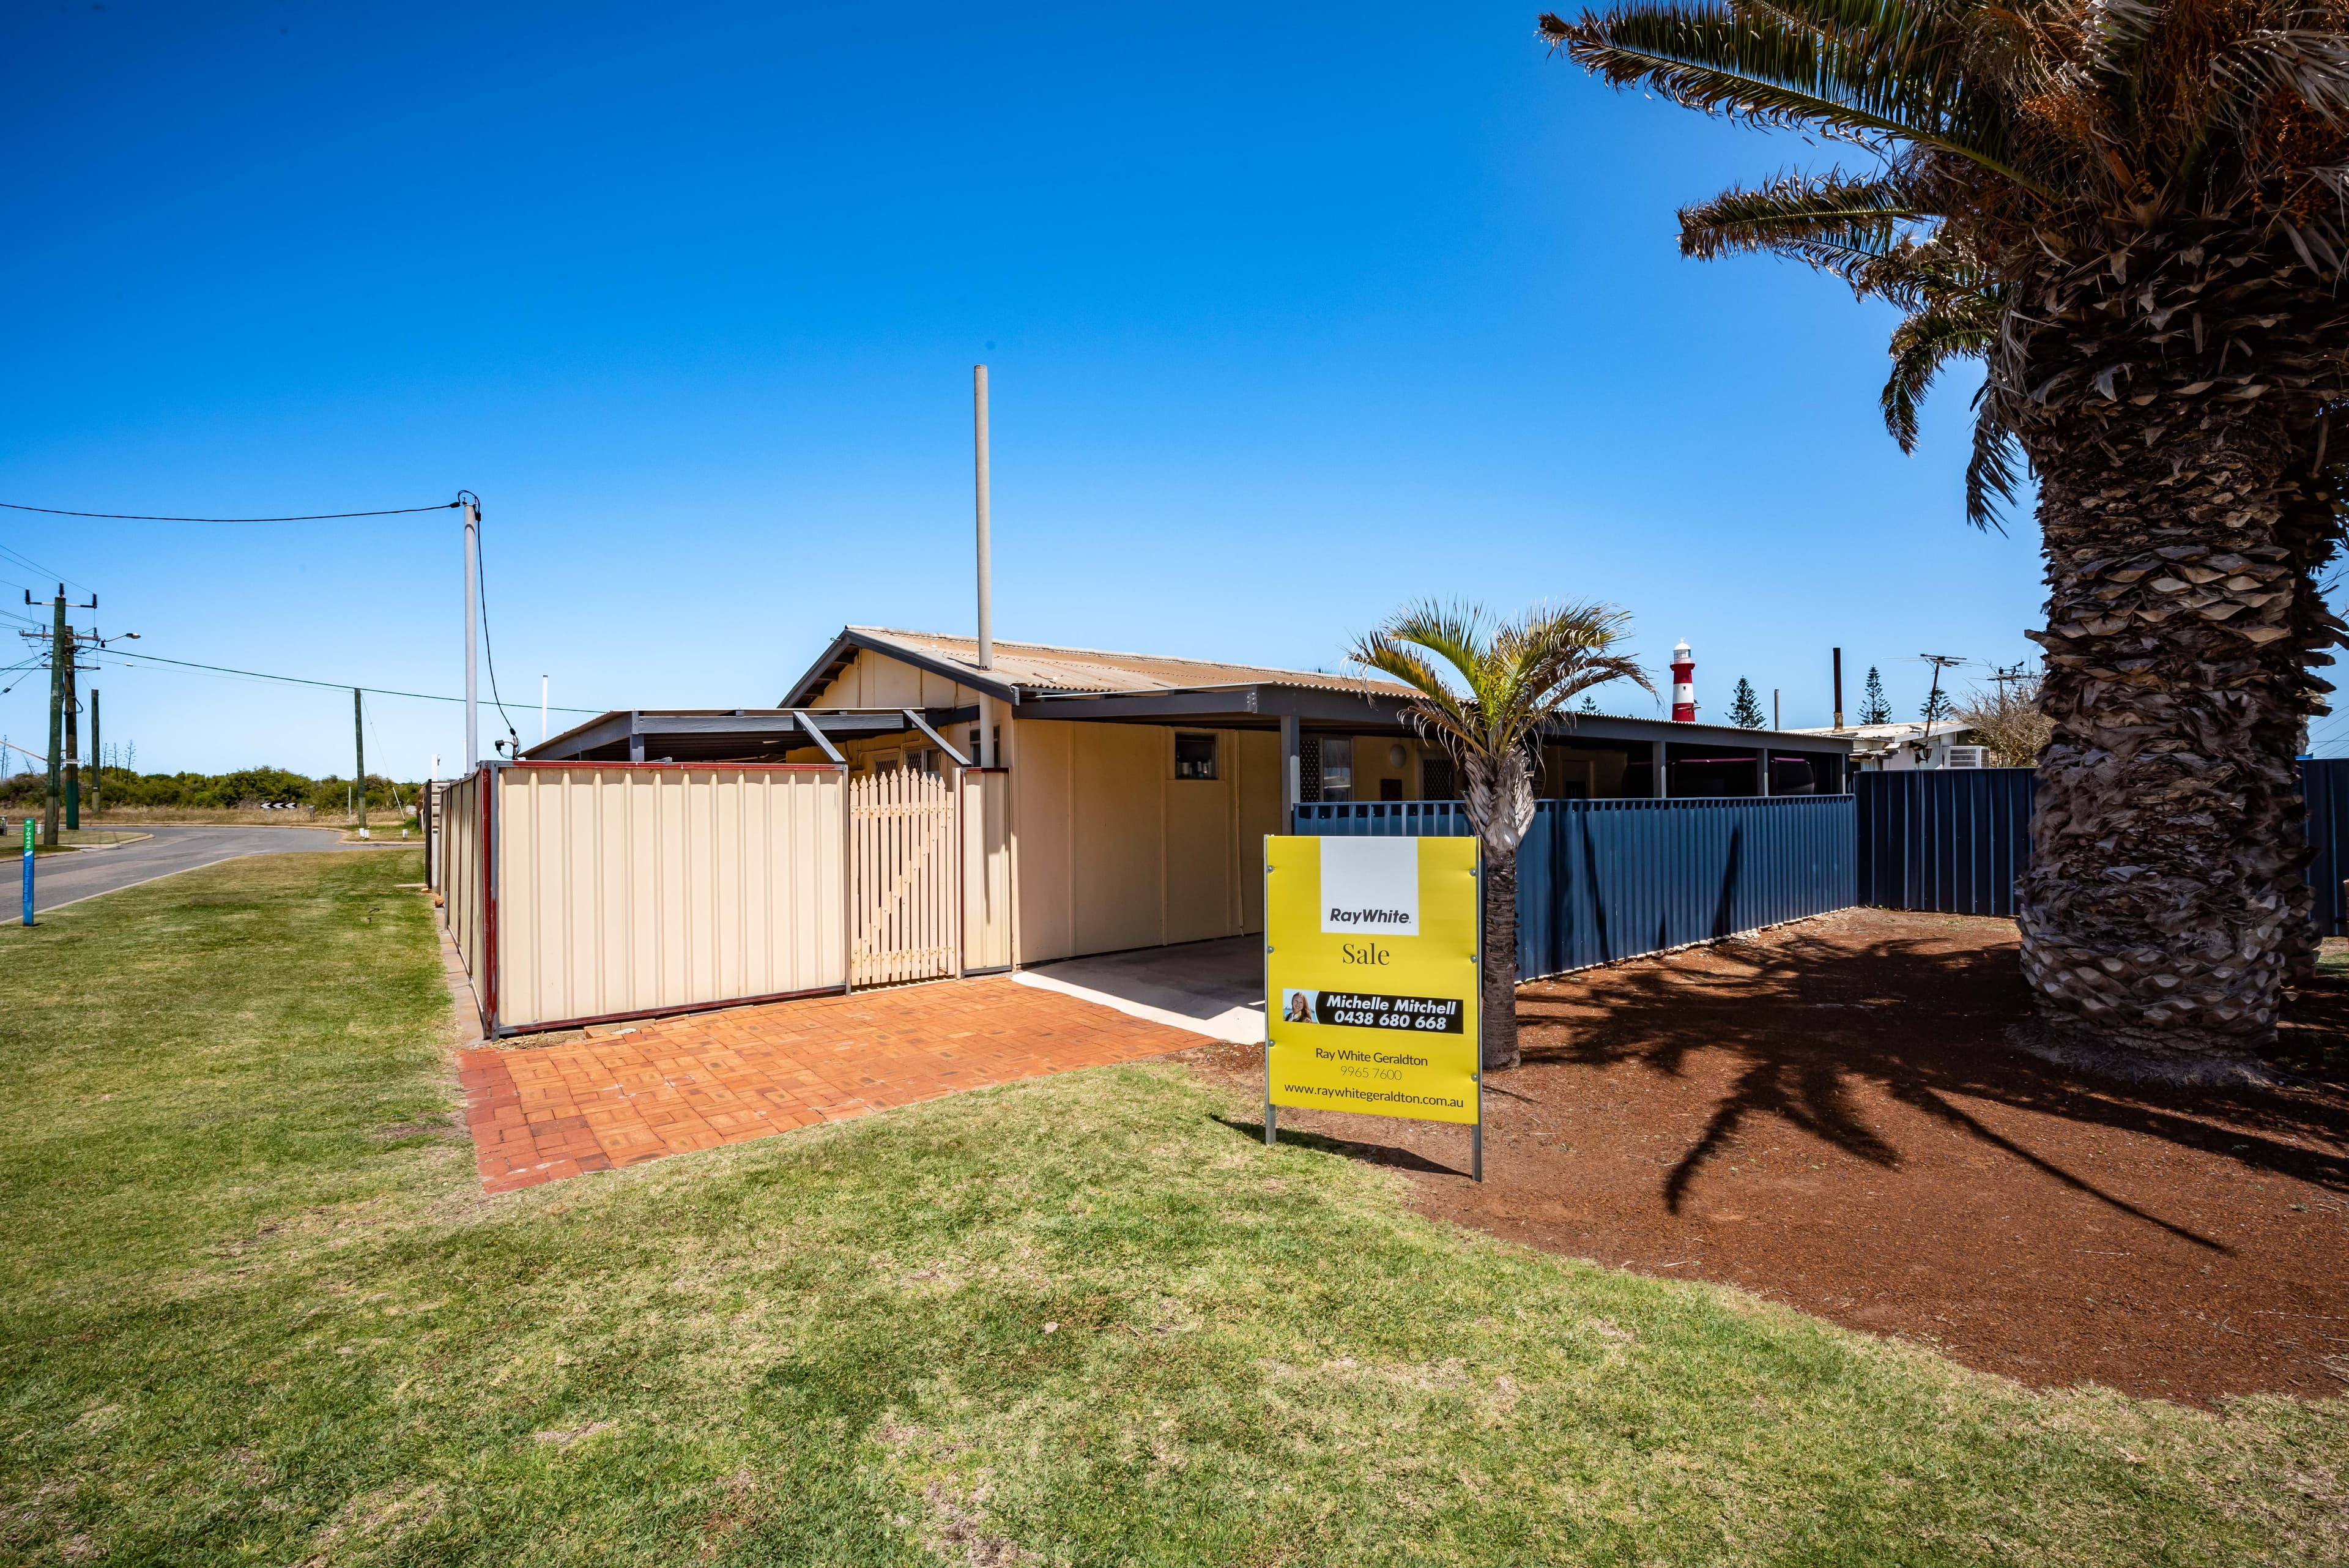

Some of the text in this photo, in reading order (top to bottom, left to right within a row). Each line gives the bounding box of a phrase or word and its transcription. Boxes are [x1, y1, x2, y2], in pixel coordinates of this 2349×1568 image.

[1343, 943, 1390, 965] Sale
[1326, 995, 1457, 1015] Michelle Mitchell
[1334, 1010, 1447, 1030] 0438 680 668
[1316, 1047, 1428, 1066] Ray White Geraldton
[1340, 1066, 1402, 1080] 9965 7600
[1284, 1083, 1464, 1108] www.raywhitegeraldton.com.au
